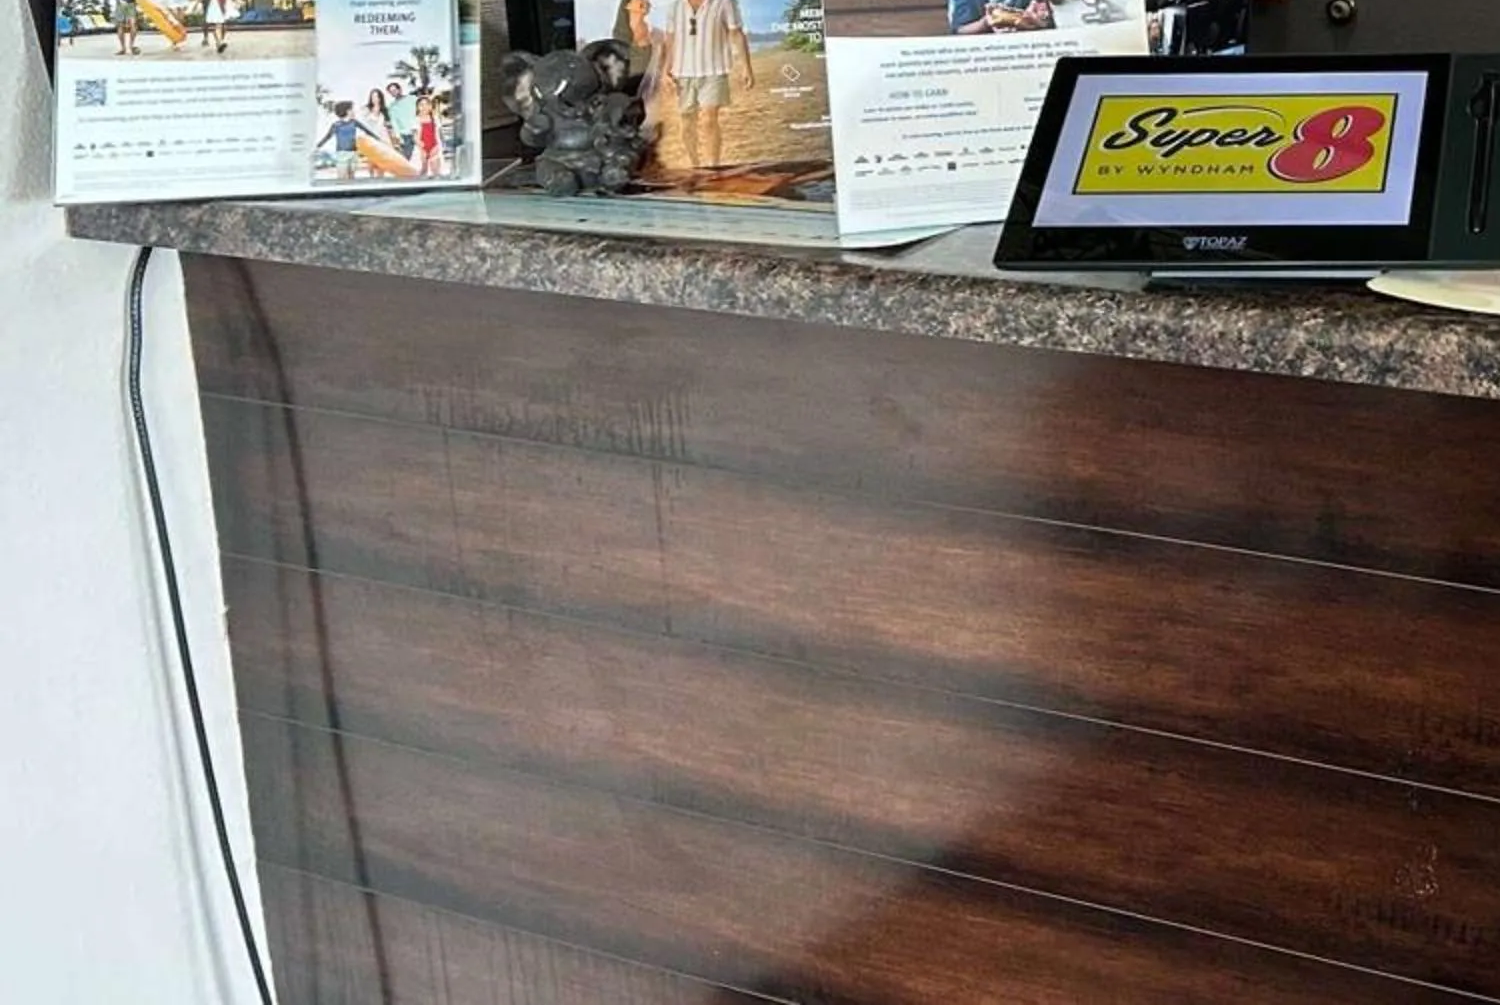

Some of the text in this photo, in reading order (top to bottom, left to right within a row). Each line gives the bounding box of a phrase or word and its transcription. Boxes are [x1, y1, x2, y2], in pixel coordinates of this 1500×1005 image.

[1103, 104, 1388, 185] Super 8
[1098, 163, 1256, 177] BY WYNDHAM
[1199, 235, 1248, 247] TOPAZ
